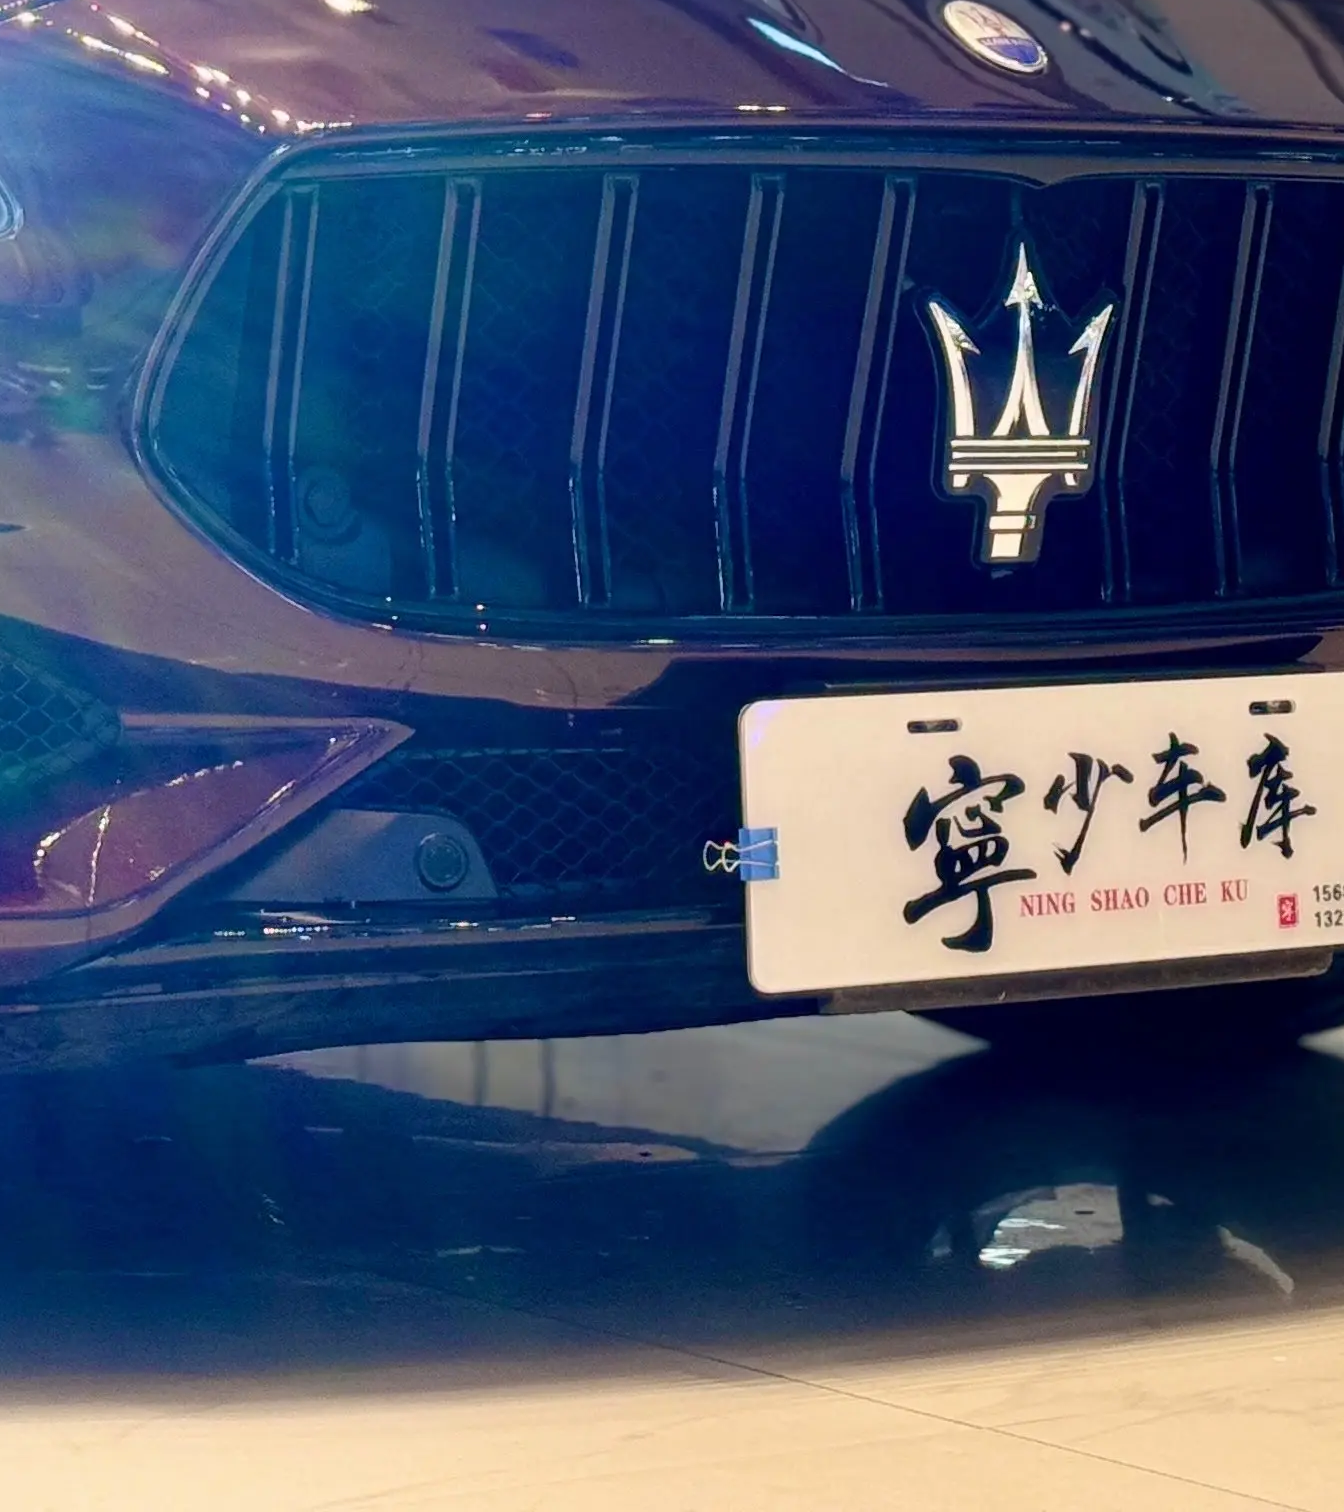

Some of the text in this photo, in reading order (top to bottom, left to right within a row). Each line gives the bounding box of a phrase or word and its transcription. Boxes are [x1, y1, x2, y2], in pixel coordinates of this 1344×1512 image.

[1019, 879, 1249, 917] NING SHAO CHE KU
